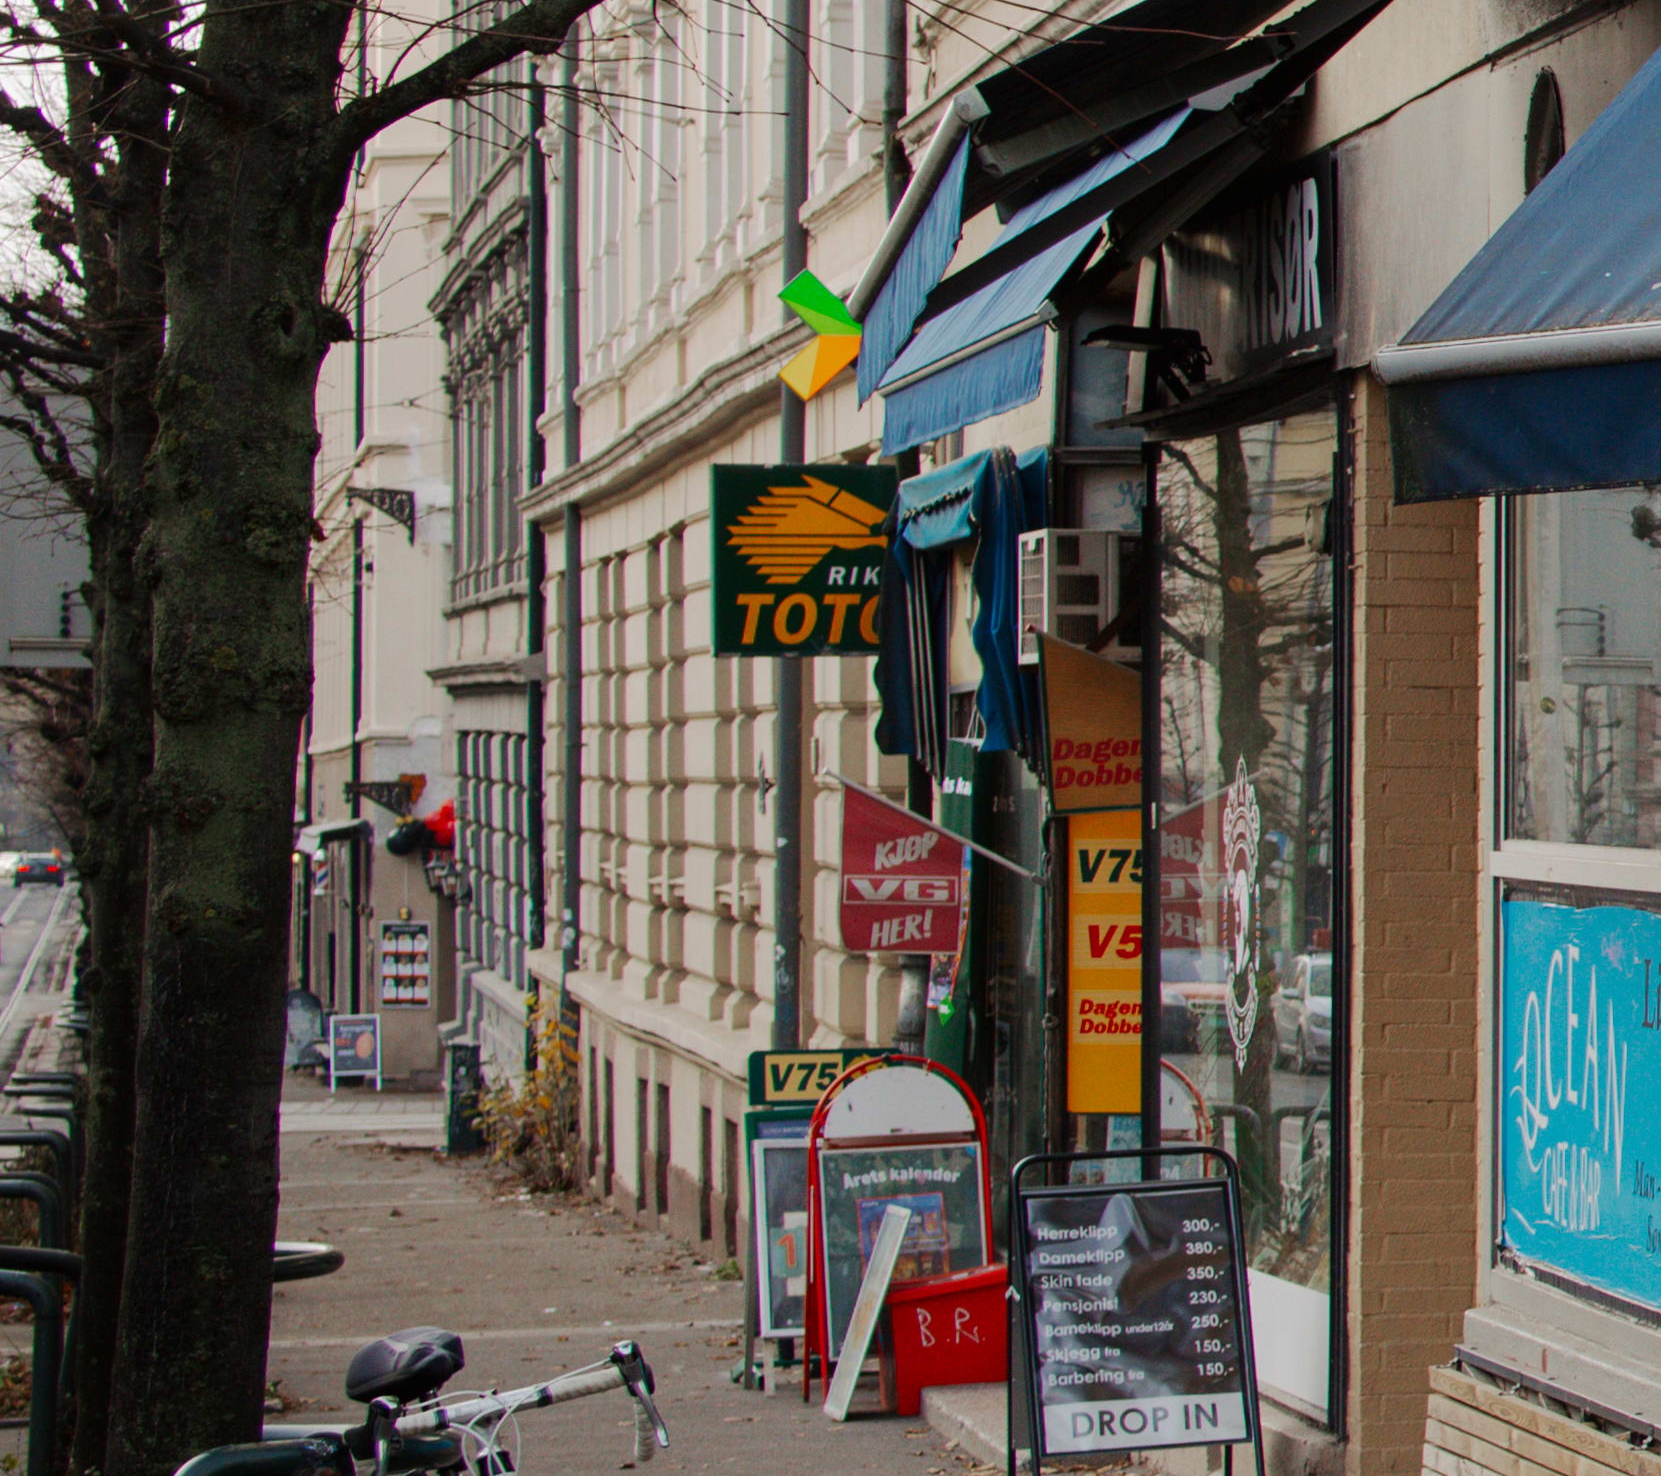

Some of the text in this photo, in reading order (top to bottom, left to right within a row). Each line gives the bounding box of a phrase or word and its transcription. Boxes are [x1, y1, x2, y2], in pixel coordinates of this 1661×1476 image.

[874, 831, 939, 871] KJØP
[850, 879, 949, 901] VG
[870, 908, 934, 948] HER!
[1079, 998, 1142, 1019] Dagen
[1079, 1017, 1142, 1035] Dobbe
[770, 1062, 838, 1092] V75
[1514, 943, 1628, 1197] OCEAN
[843, 1167, 961, 1190] Årets kalender
[1542, 1141, 1569, 1227] CAFE
[1579, 1147, 1600, 1231] BAR
[1037, 1218, 1220, 1240] Herreklipp 300,-
[1039, 1241, 1223, 1264] Dameklipp 380,-
[1041, 1265, 1225, 1290] Skin fade 350,-
[1043, 1290, 1227, 1314] Pensjonist 230,-
[1044, 1322, 1121, 1337] Barneklipp
[1191, 1314, 1229, 1329] 250,-
[1046, 1339, 1231, 1363] Skjegg fra 150,-
[1047, 1363, 1234, 1386] Barbering fra 150,-
[1071, 1402, 1219, 1439] DROP IN
